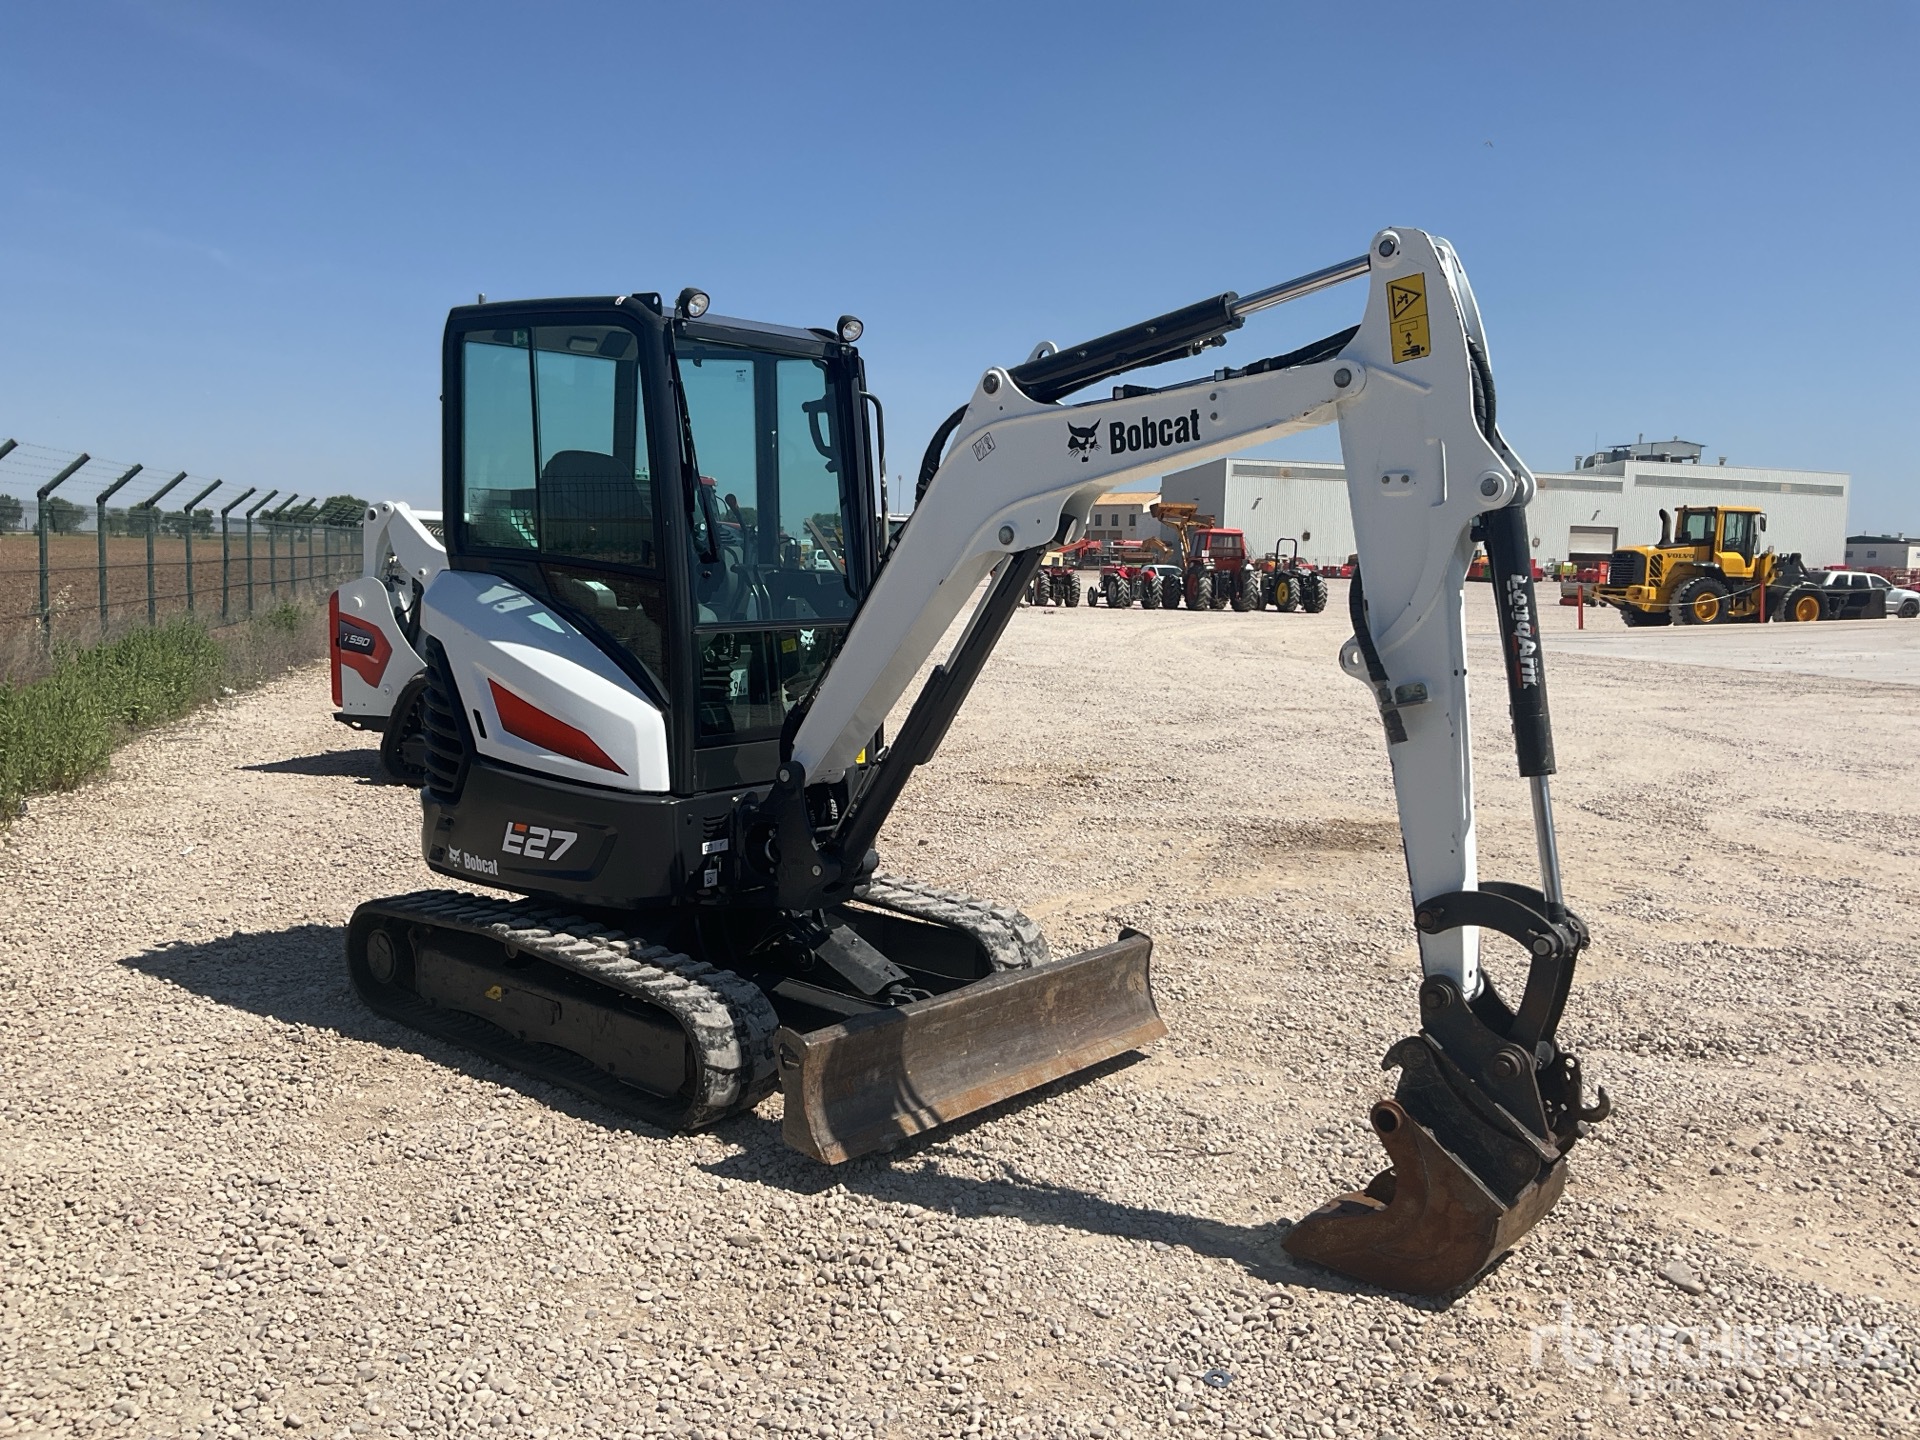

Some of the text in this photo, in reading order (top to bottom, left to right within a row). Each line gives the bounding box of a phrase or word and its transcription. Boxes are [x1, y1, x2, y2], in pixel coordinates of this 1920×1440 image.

[1109, 408, 1201, 455] Bobcat
[502, 821, 578, 861] E27
[464, 852, 499, 876] Bobcat
